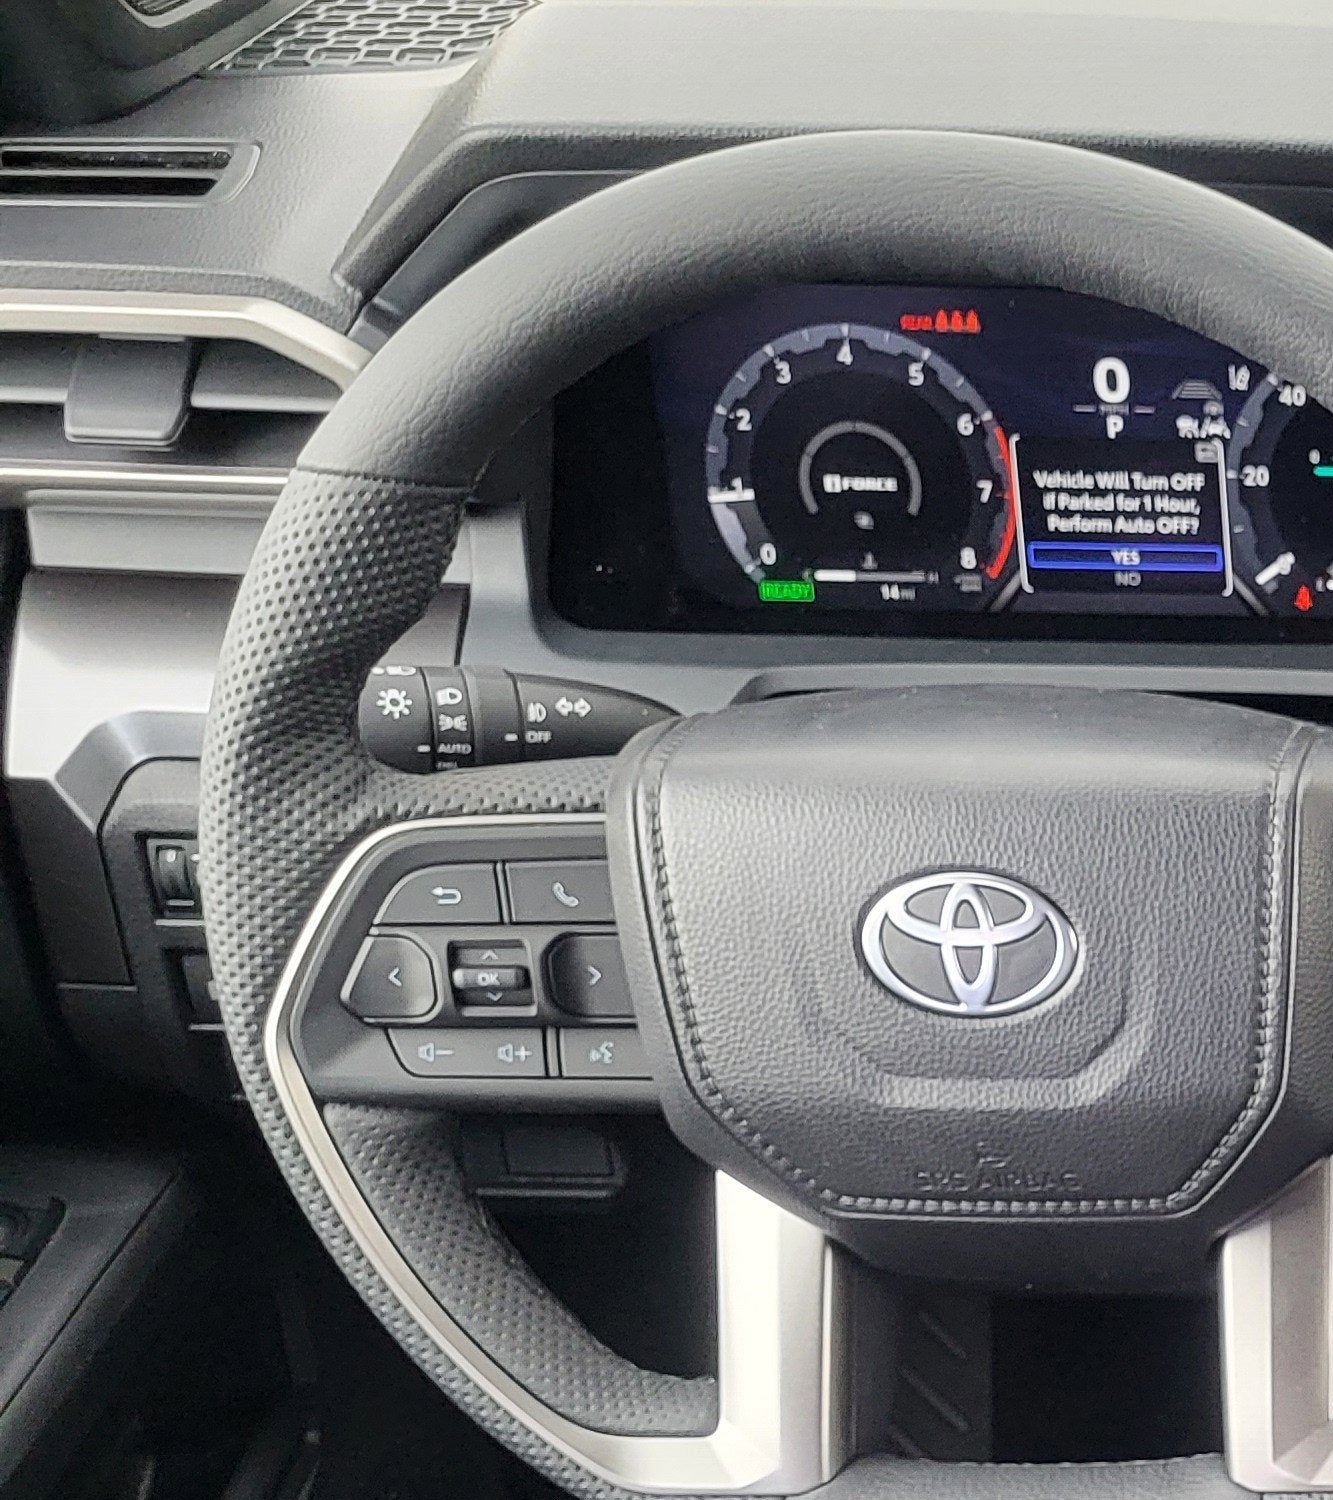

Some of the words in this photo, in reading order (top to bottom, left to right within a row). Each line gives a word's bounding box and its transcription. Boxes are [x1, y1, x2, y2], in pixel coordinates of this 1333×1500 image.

[775, 361, 792, 385] 3
[908, 362, 925, 387] 5
[1092, 356, 1131, 404] 0
[1277, 384, 1308, 408] 40
[735, 407, 753, 432] 2
[956, 413, 974, 437] 6
[1105, 414, 1125, 440] P
[1032, 469, 1095, 489] Vehicle
[1095, 470, 1131, 490] Will
[1130, 471, 1169, 491] Turn
[1170, 472, 1206, 492] OFF
[1241, 464, 1271, 488] 20
[976, 480, 993, 503] 7
[1057, 491, 1115, 512] Parked
[1115, 493, 1142, 512] for
[1047, 513, 1113, 533] Perform
[1114, 515, 1155, 535] Auto
[1156, 516, 1200, 536] OFF?
[759, 542, 776, 566] 0
[1110, 549, 1141, 567] YES
[1113, 570, 1142, 587] NO
[477, 972, 499, 986] OK
